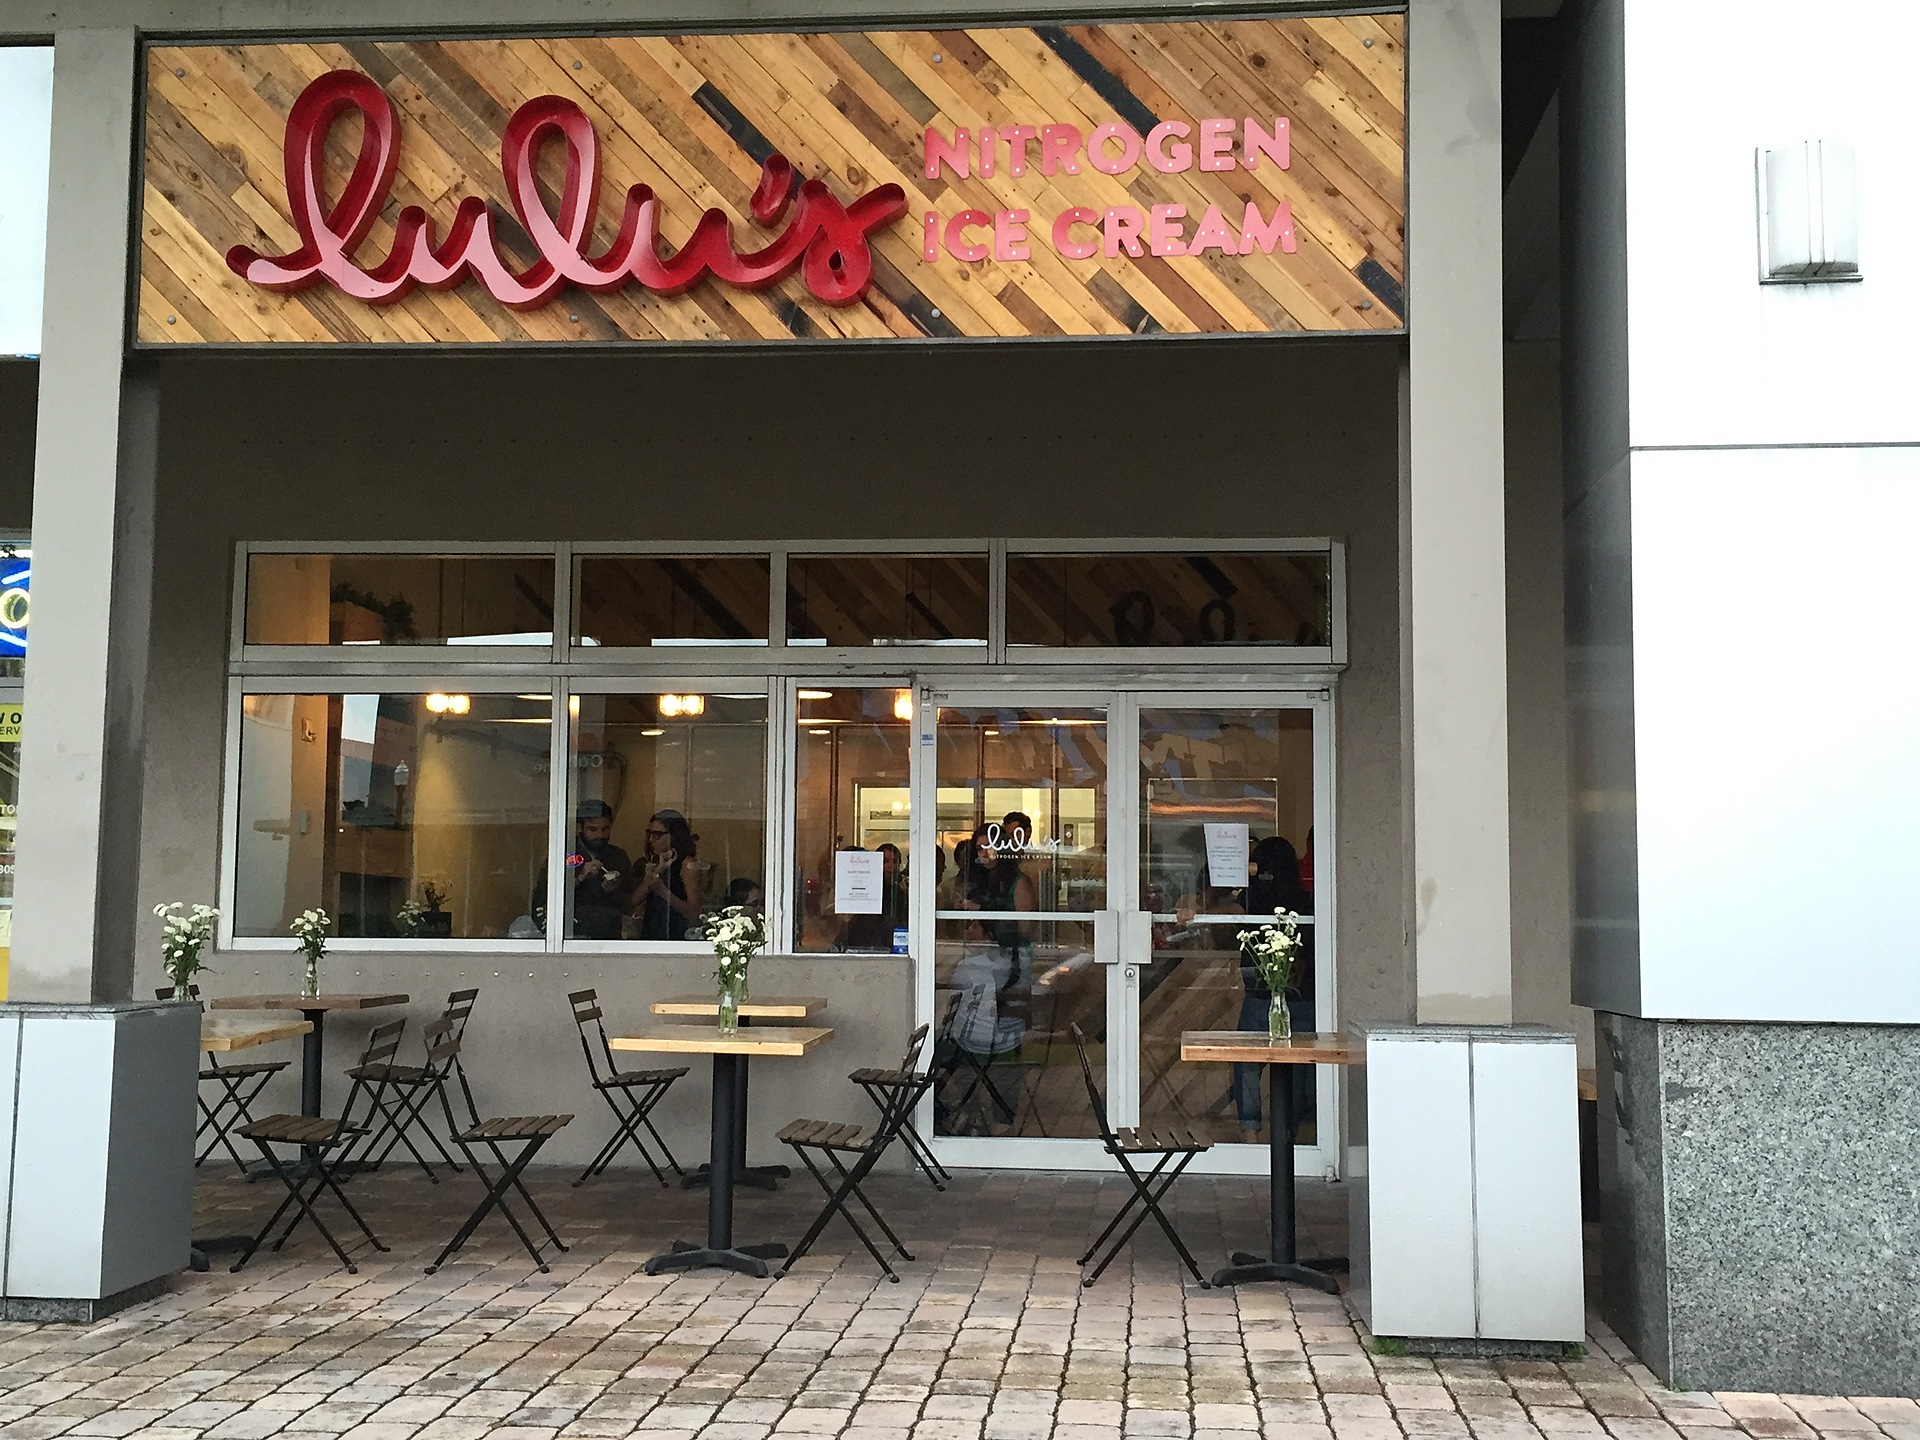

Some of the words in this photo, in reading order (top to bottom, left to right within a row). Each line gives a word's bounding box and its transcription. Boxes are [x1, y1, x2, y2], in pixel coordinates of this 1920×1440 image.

[924, 116, 1291, 179] NITROGEN
[226, 69, 909, 309] lulu's
[923, 208, 1031, 262] ICE
[1051, 199, 1298, 259] CREAM
